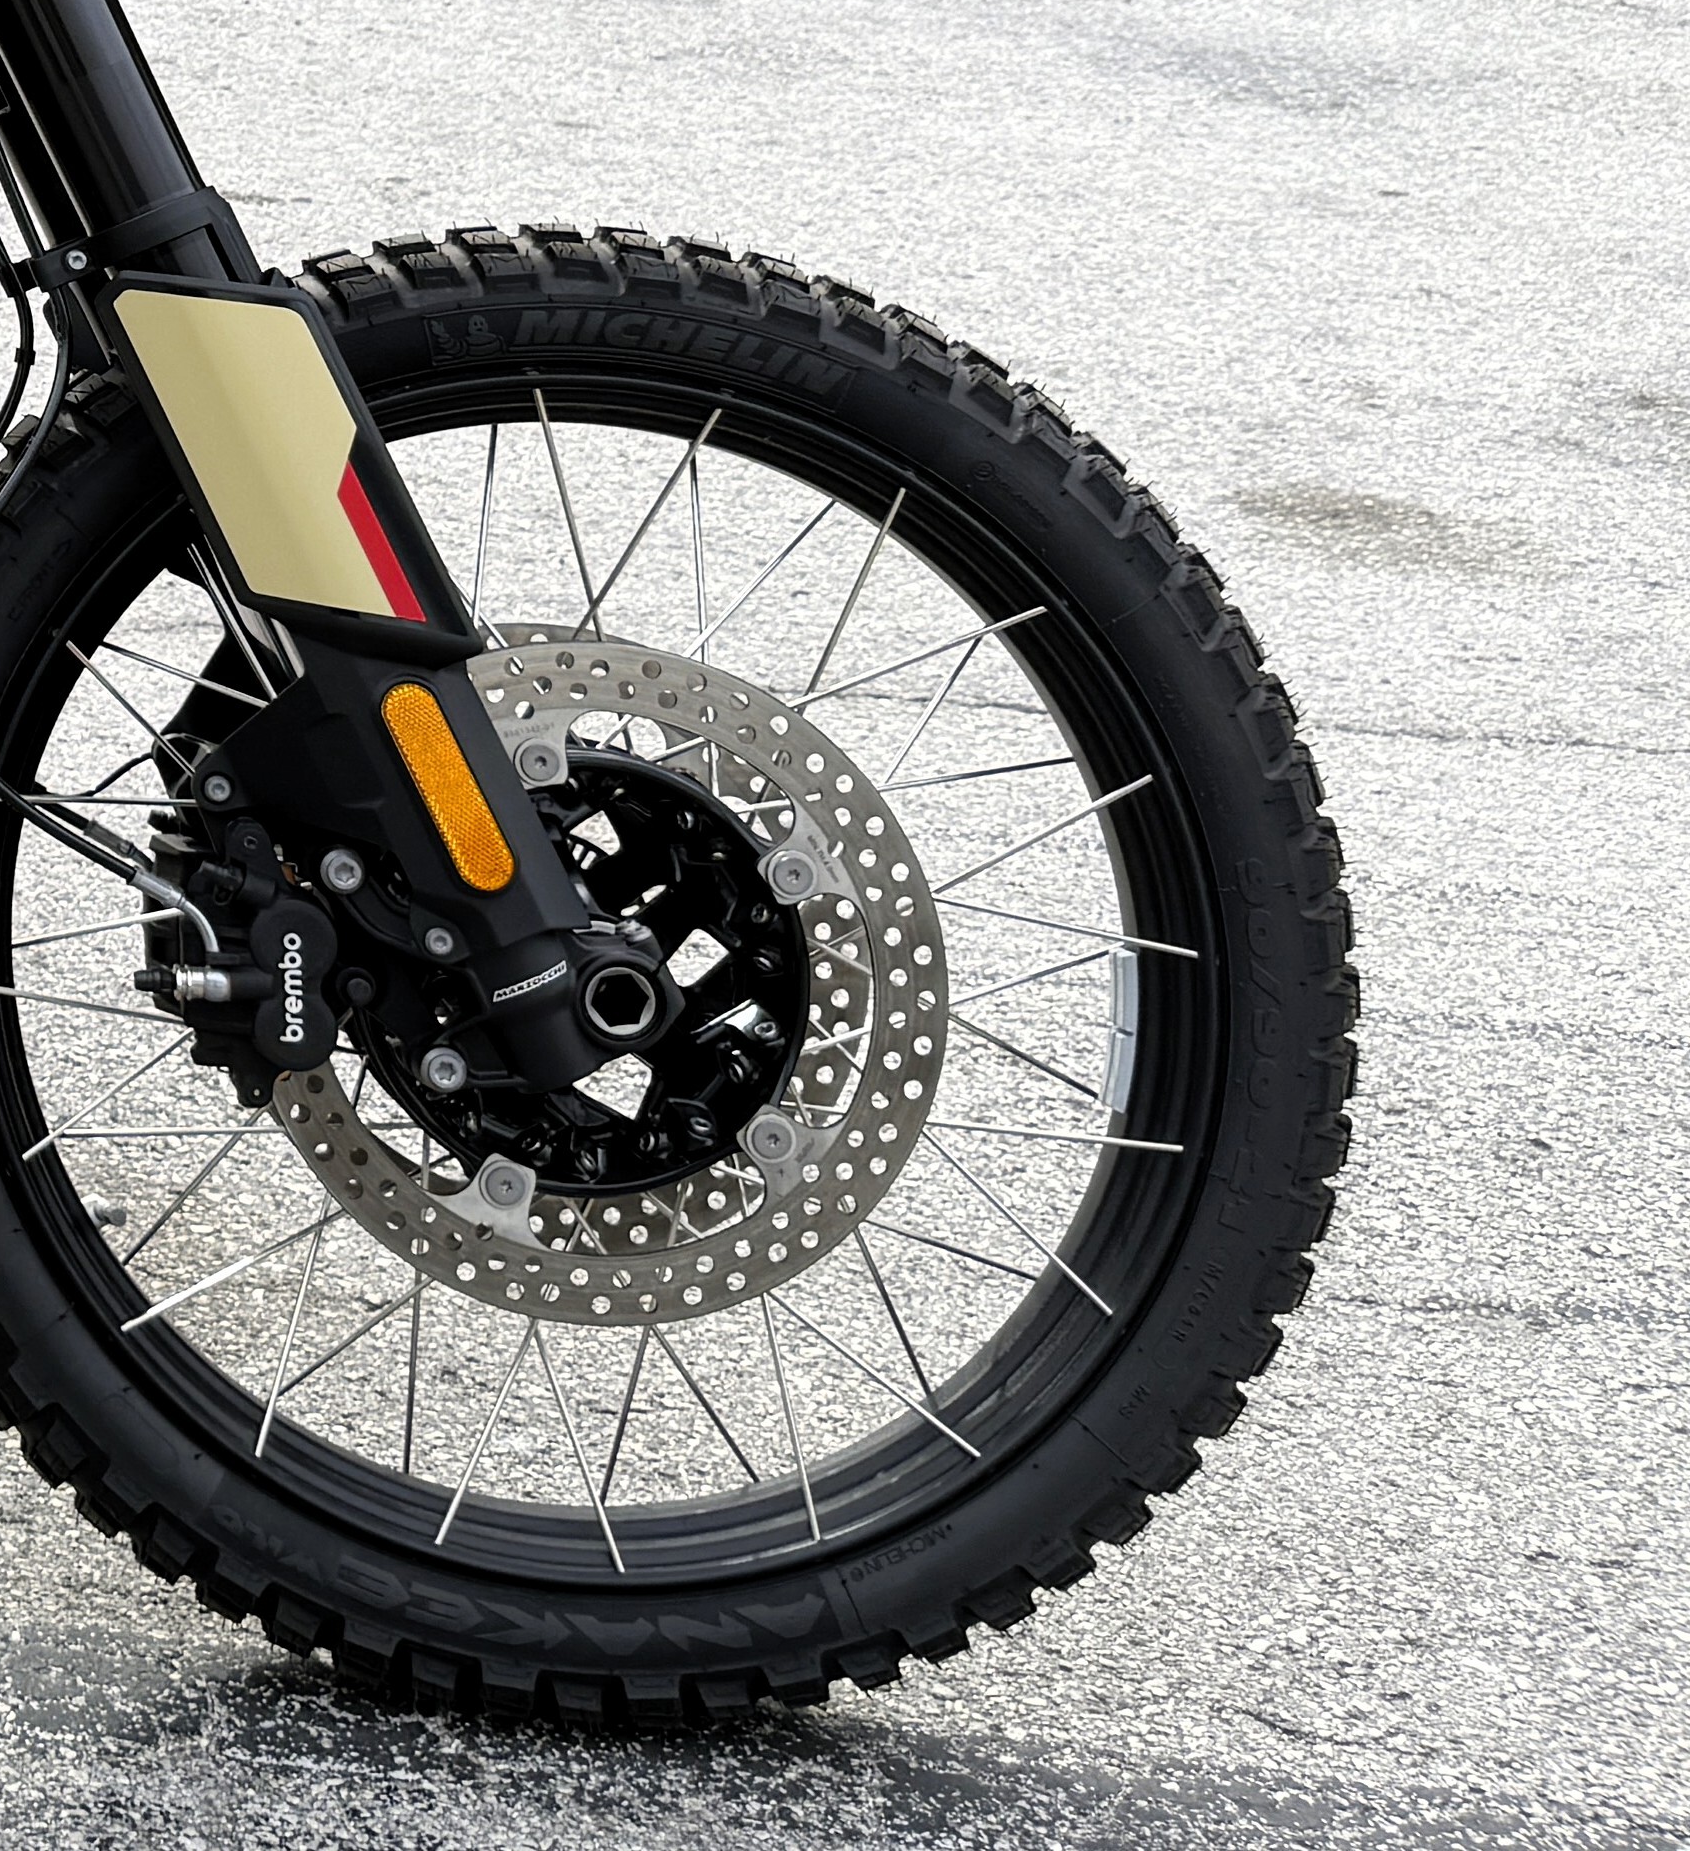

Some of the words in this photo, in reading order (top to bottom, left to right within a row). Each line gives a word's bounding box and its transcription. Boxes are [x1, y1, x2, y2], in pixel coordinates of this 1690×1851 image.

[516, 309, 849, 399] MICHELIN
[279, 931, 303, 1044] brembo
[217, 1505, 321, 1580] WILD
[338, 1563, 826, 1654] ANAKEE
